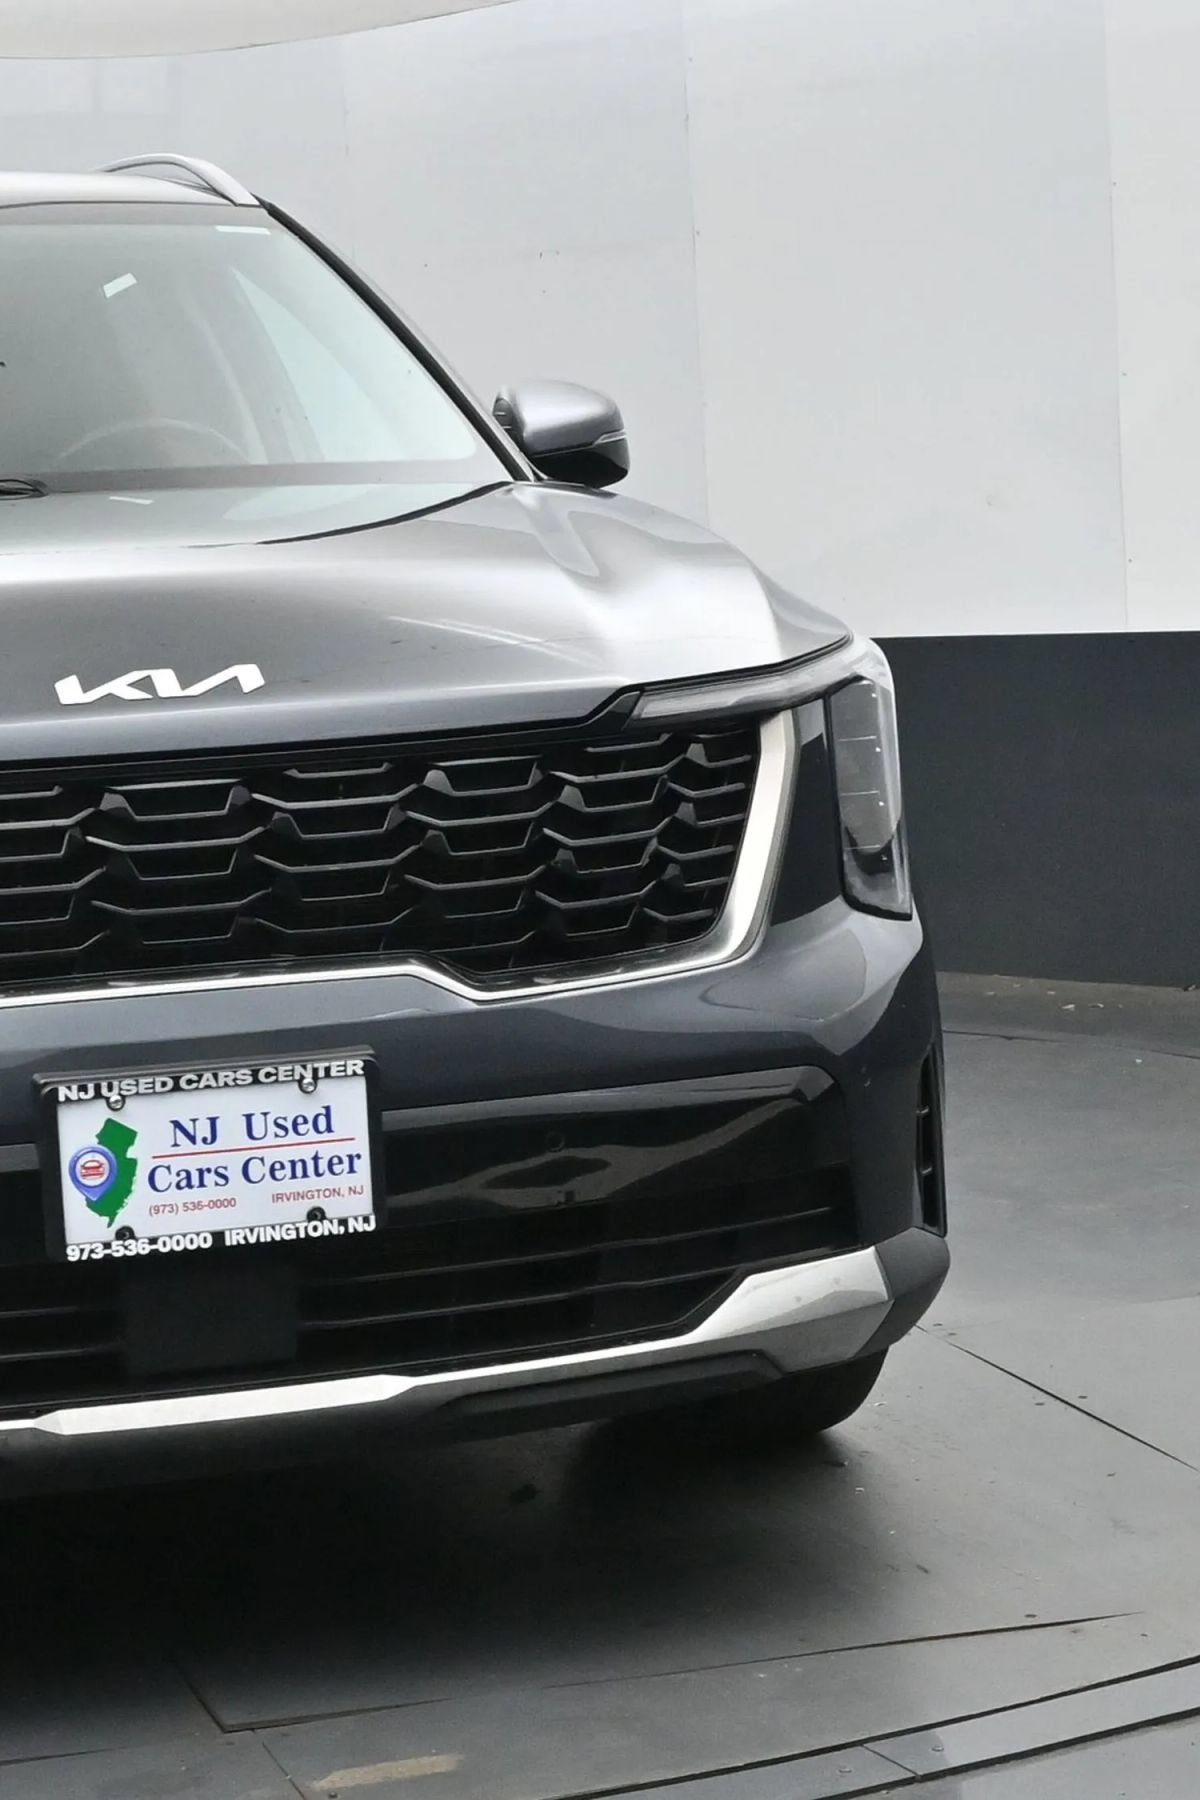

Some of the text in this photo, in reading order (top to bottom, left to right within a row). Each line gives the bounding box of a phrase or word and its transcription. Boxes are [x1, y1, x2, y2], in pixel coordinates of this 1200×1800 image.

[58, 1060, 365, 1102] NJ USED CARS CENTER
[170, 1105, 335, 1148] NJ Used
[147, 1150, 362, 1193] Cars Center
[148, 1197, 237, 1217] (973) 536-0000
[272, 1185, 364, 1203] IRVINGTON, NJ
[224, 1215, 376, 1246] IRVINGTON, NJ
[66, 1233, 213, 1262] 973-536-0000
